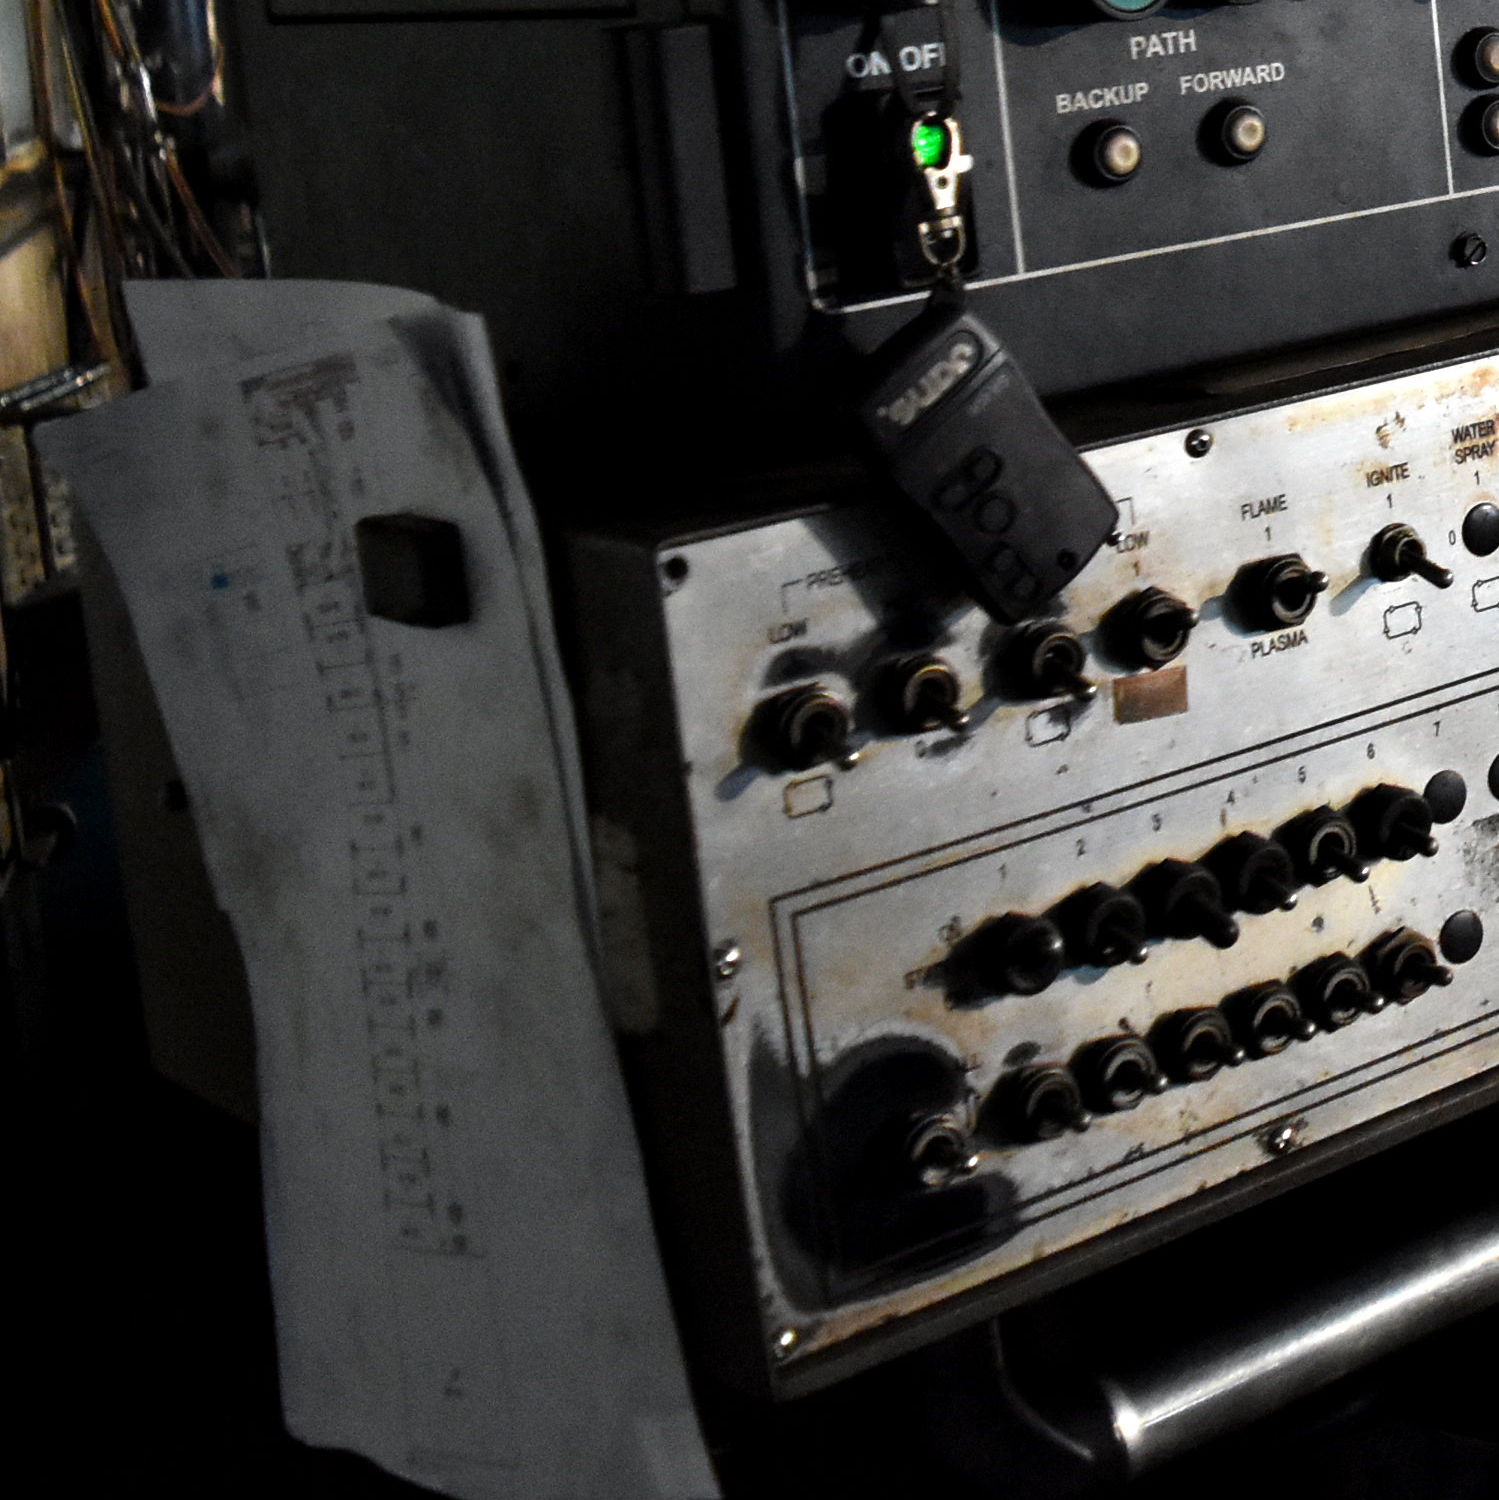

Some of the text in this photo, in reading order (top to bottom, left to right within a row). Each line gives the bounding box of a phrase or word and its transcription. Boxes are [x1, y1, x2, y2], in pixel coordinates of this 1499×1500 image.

[1129, 29, 1197, 60] PATH
[1179, 61, 1286, 97] FORWARD
[1055, 82, 1150, 116] BACKUP
[1451, 419, 1496, 444] WATER
[1454, 439, 1498, 465] SPRAY
[1366, 462, 1411, 489] IGNITE
[1474, 470, 1481, 486] 1
[1241, 493, 1288, 522] FLAME
[1386, 493, 1394, 509] 1
[1250, 628, 1309, 659] PLASMA
